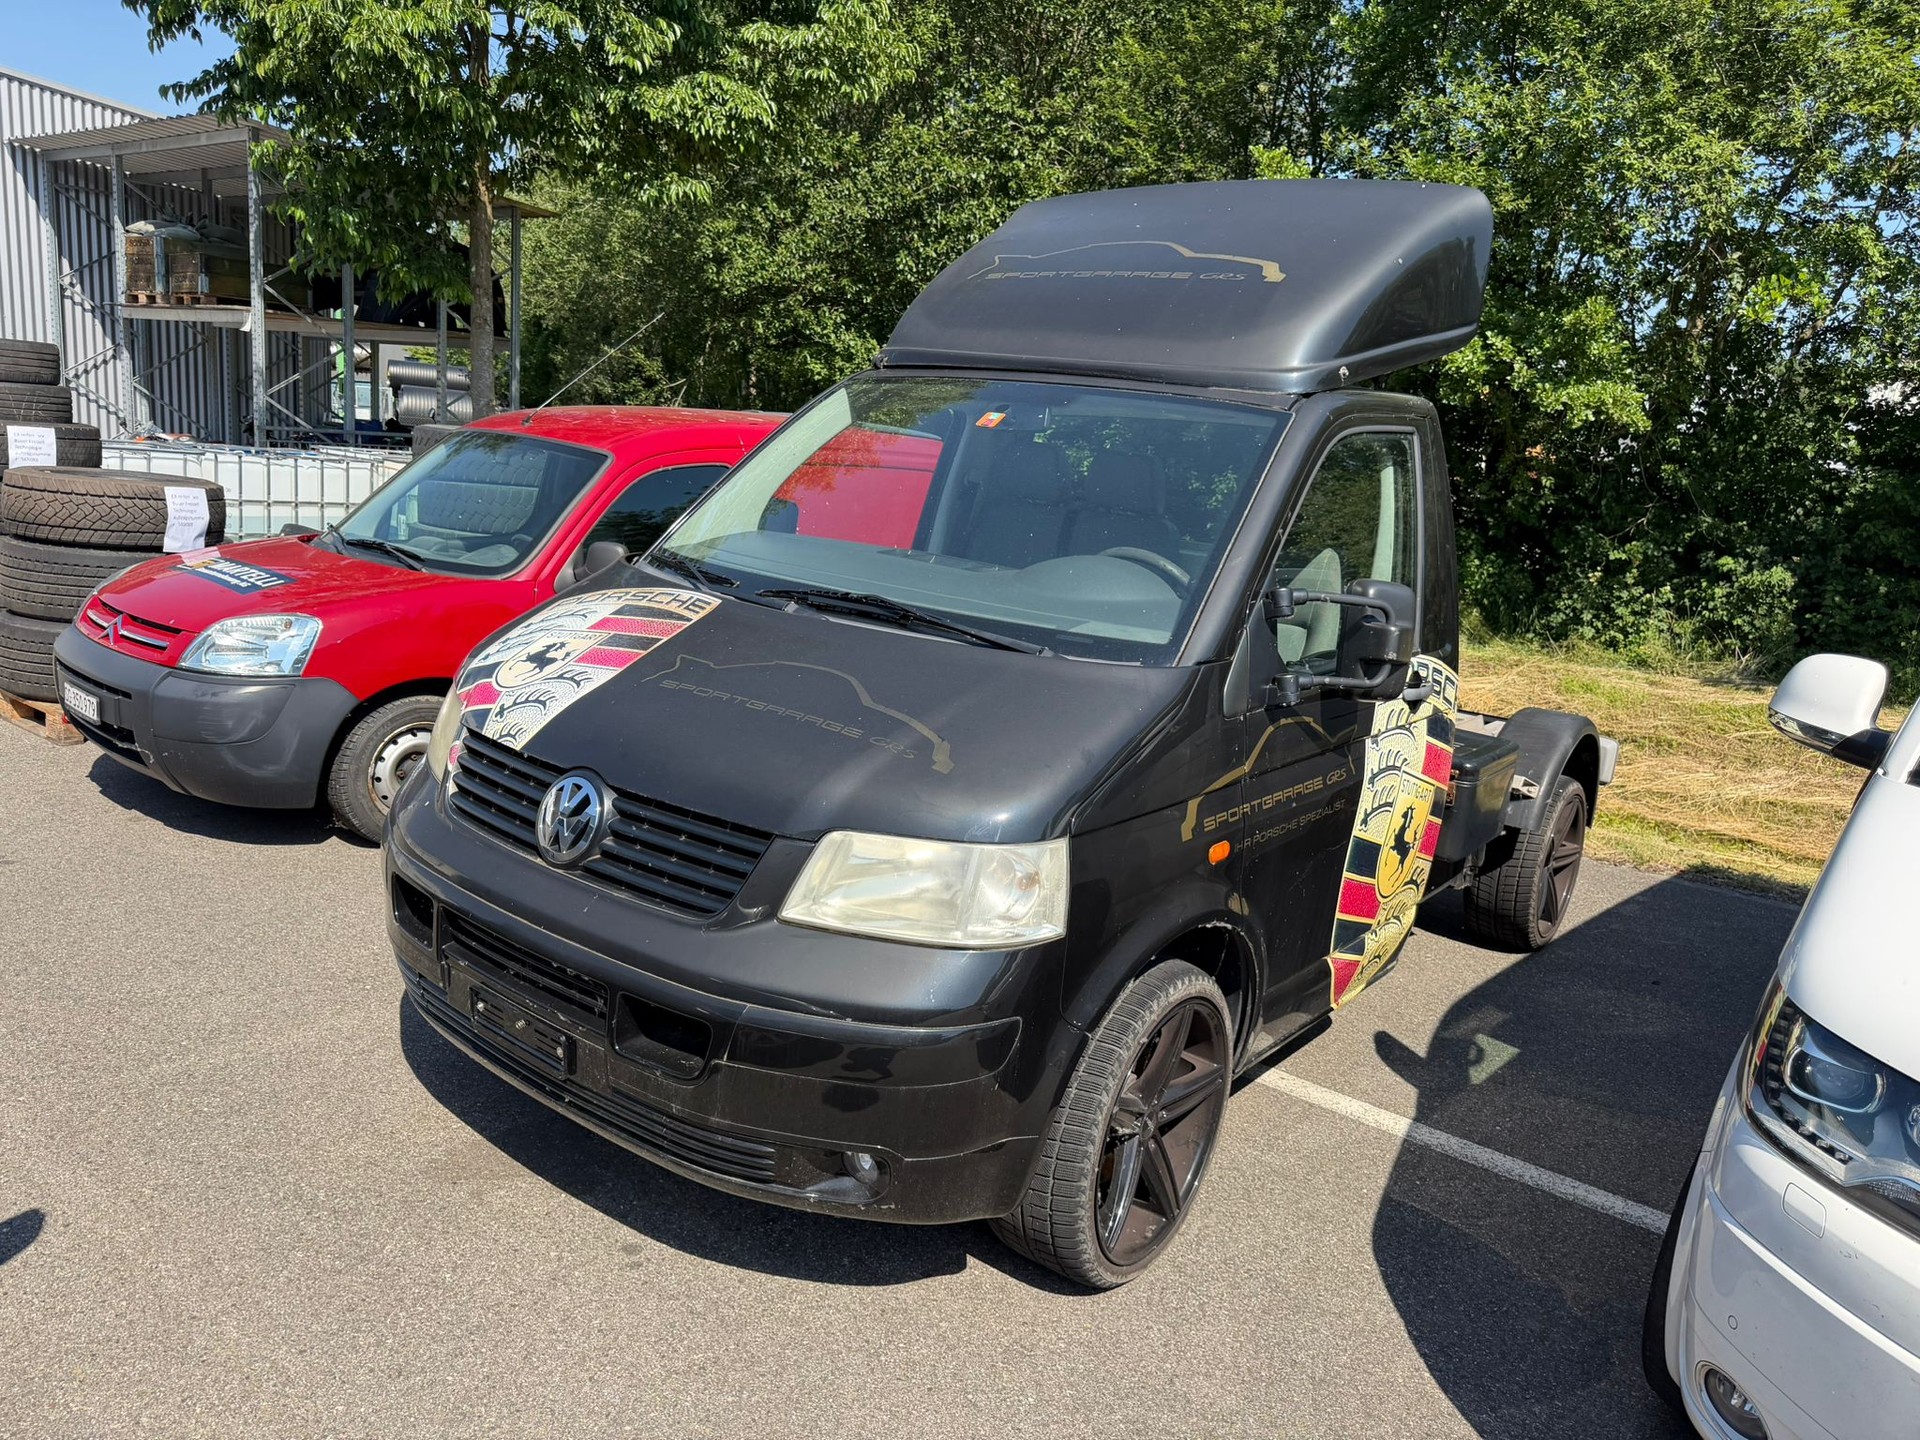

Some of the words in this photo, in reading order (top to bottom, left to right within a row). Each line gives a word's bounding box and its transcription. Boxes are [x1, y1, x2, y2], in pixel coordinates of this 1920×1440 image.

[984, 270, 1193, 281] SPORTGARAGE
[1199, 272, 1246, 281] GRS
[208, 560, 286, 588] MARTELLI
[549, 590, 713, 615] PORSCHE
[547, 630, 605, 642] STUTTGART
[659, 678, 865, 740] SPORTGARAGE
[869, 735, 919, 760] GRS
[1203, 775, 1323, 833] SPORTGARAGE
[1326, 767, 1347, 785] GRS
[1401, 778, 1432, 803] STUTTGART
[1234, 837, 1251, 853] IHR
[1253, 820, 1298, 845] PORSCHE
[1299, 799, 1346, 827] SPEZIALIST
